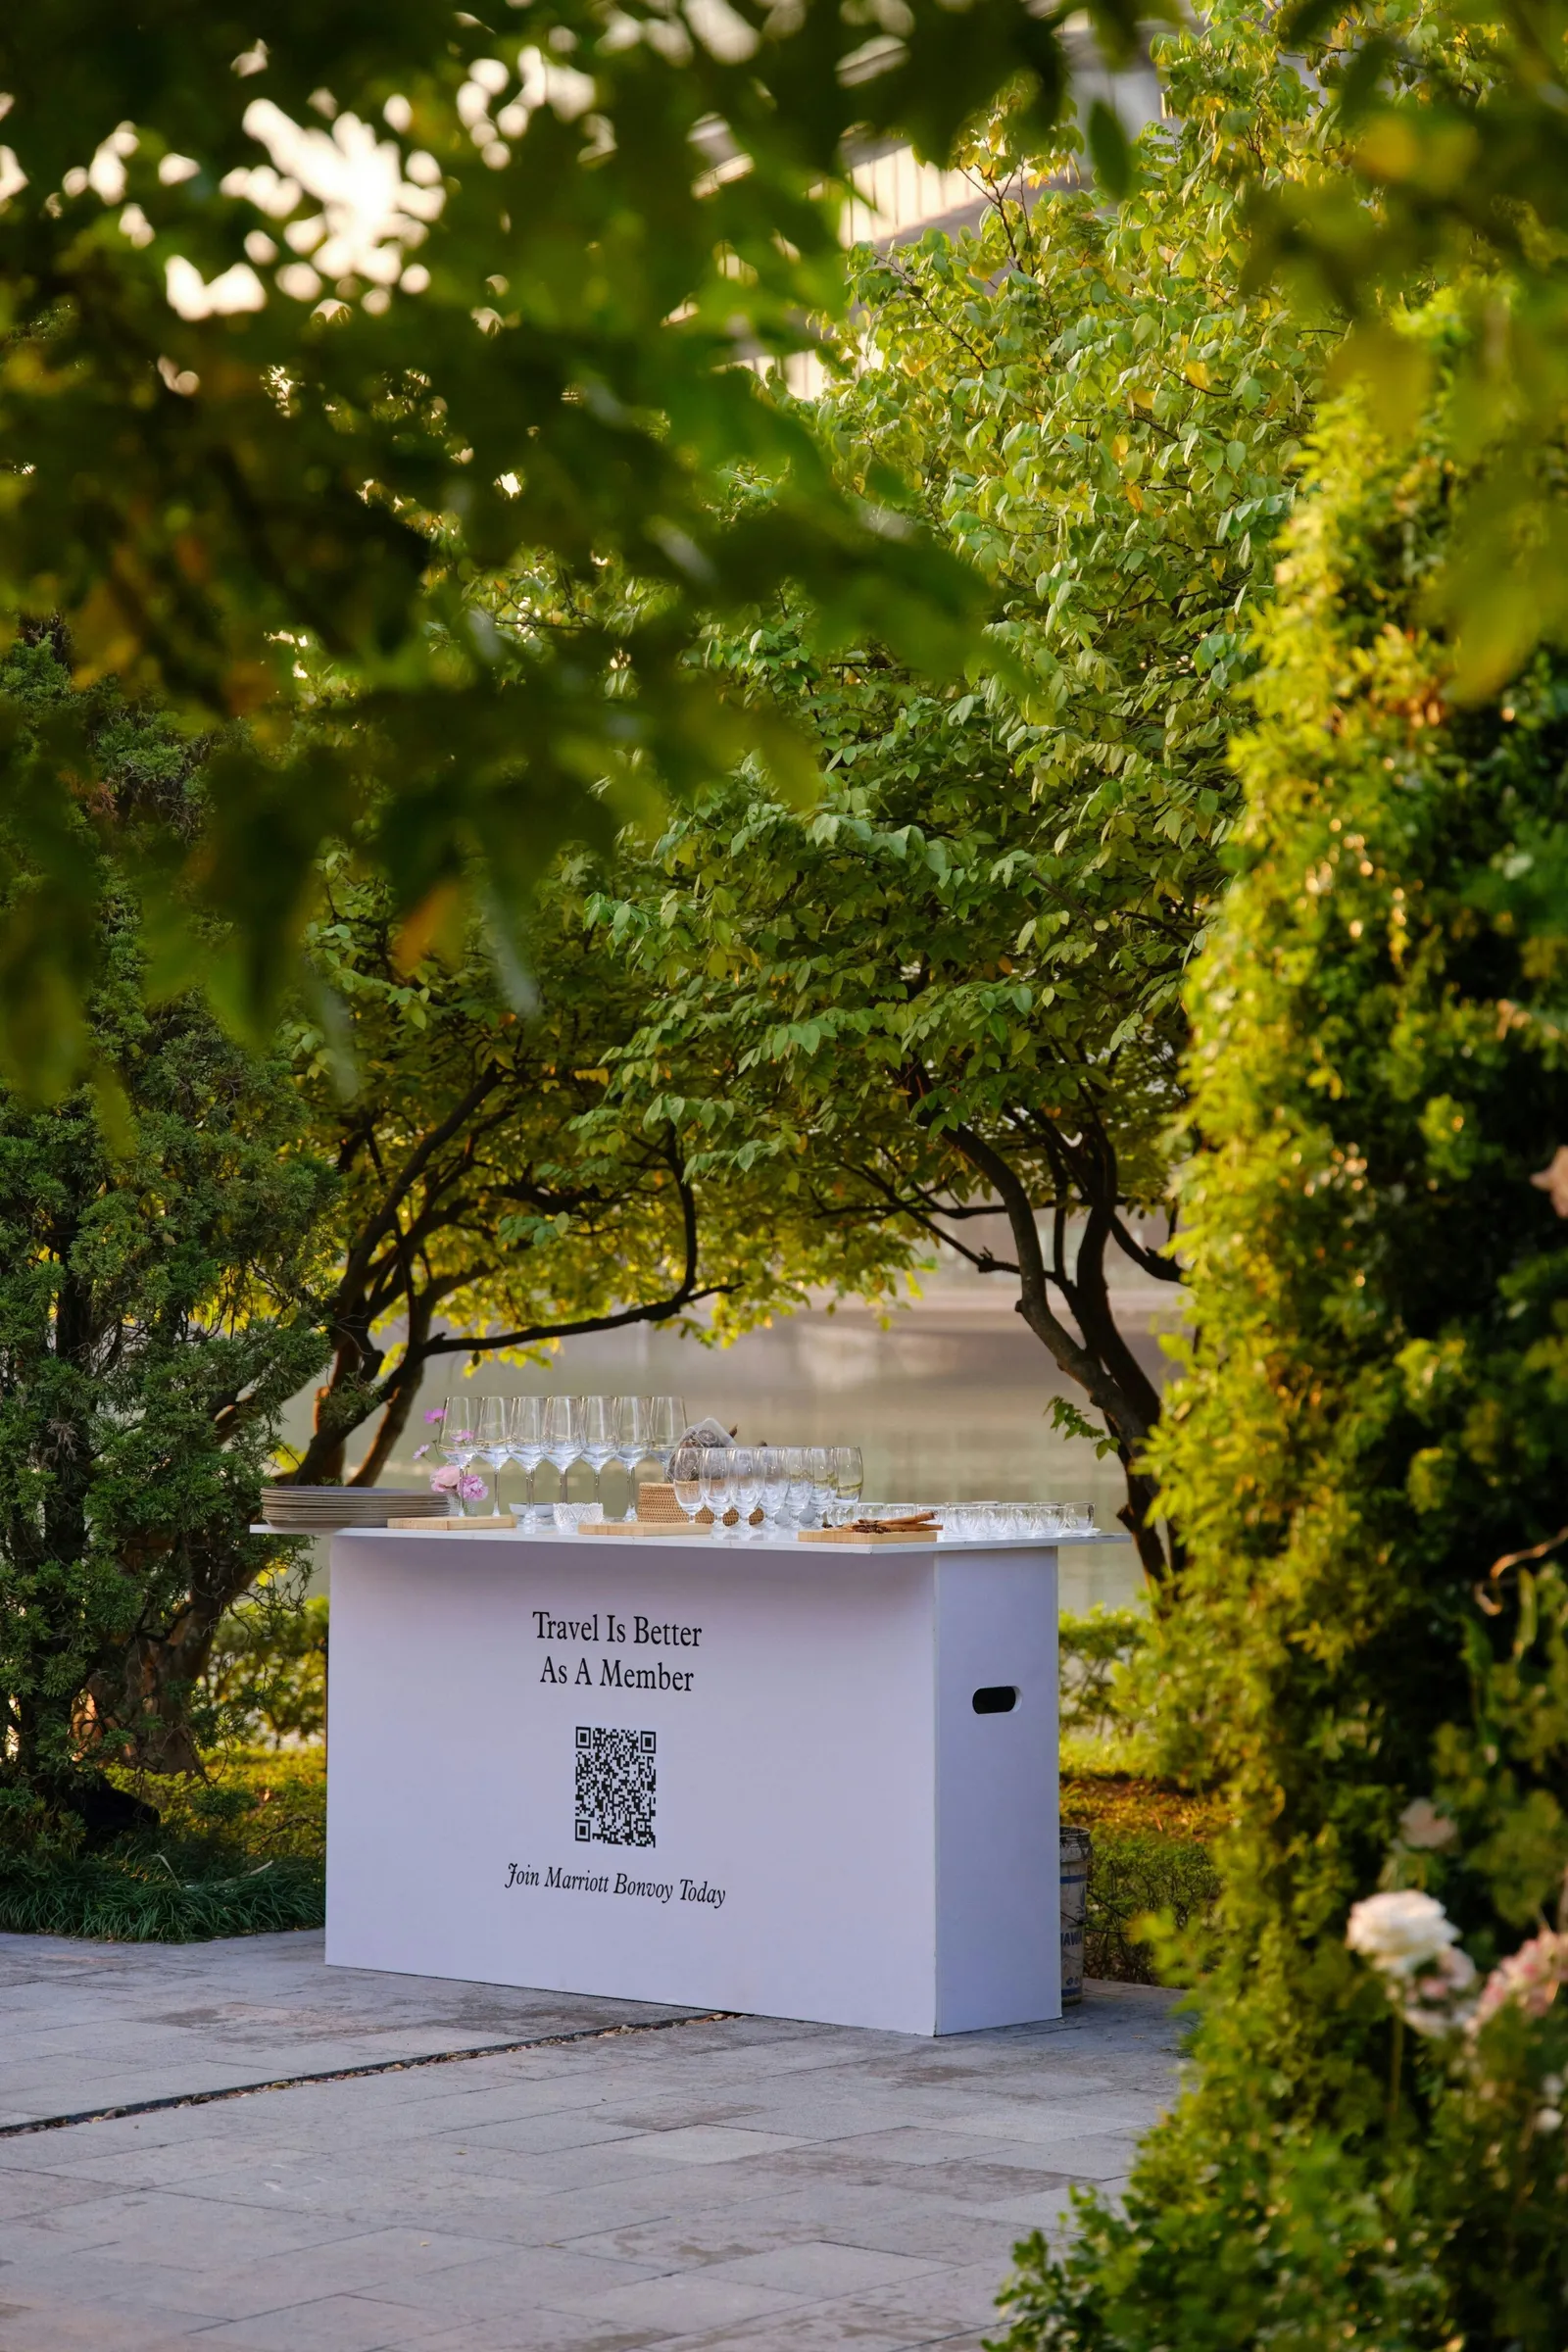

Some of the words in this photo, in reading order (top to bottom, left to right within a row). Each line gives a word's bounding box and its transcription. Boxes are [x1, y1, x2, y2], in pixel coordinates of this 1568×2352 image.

[532, 1611, 600, 1642] Travel
[607, 1615, 626, 1643] Is
[634, 1616, 703, 1647] Better
[540, 1656, 568, 1685] As
[574, 1658, 593, 1686] A
[600, 1659, 695, 1691] Member
[505, 1863, 540, 1889] Join
[544, 1867, 610, 1893] Marriott
[613, 1873, 674, 1904] Bonvoy
[680, 1879, 726, 1910] Today
